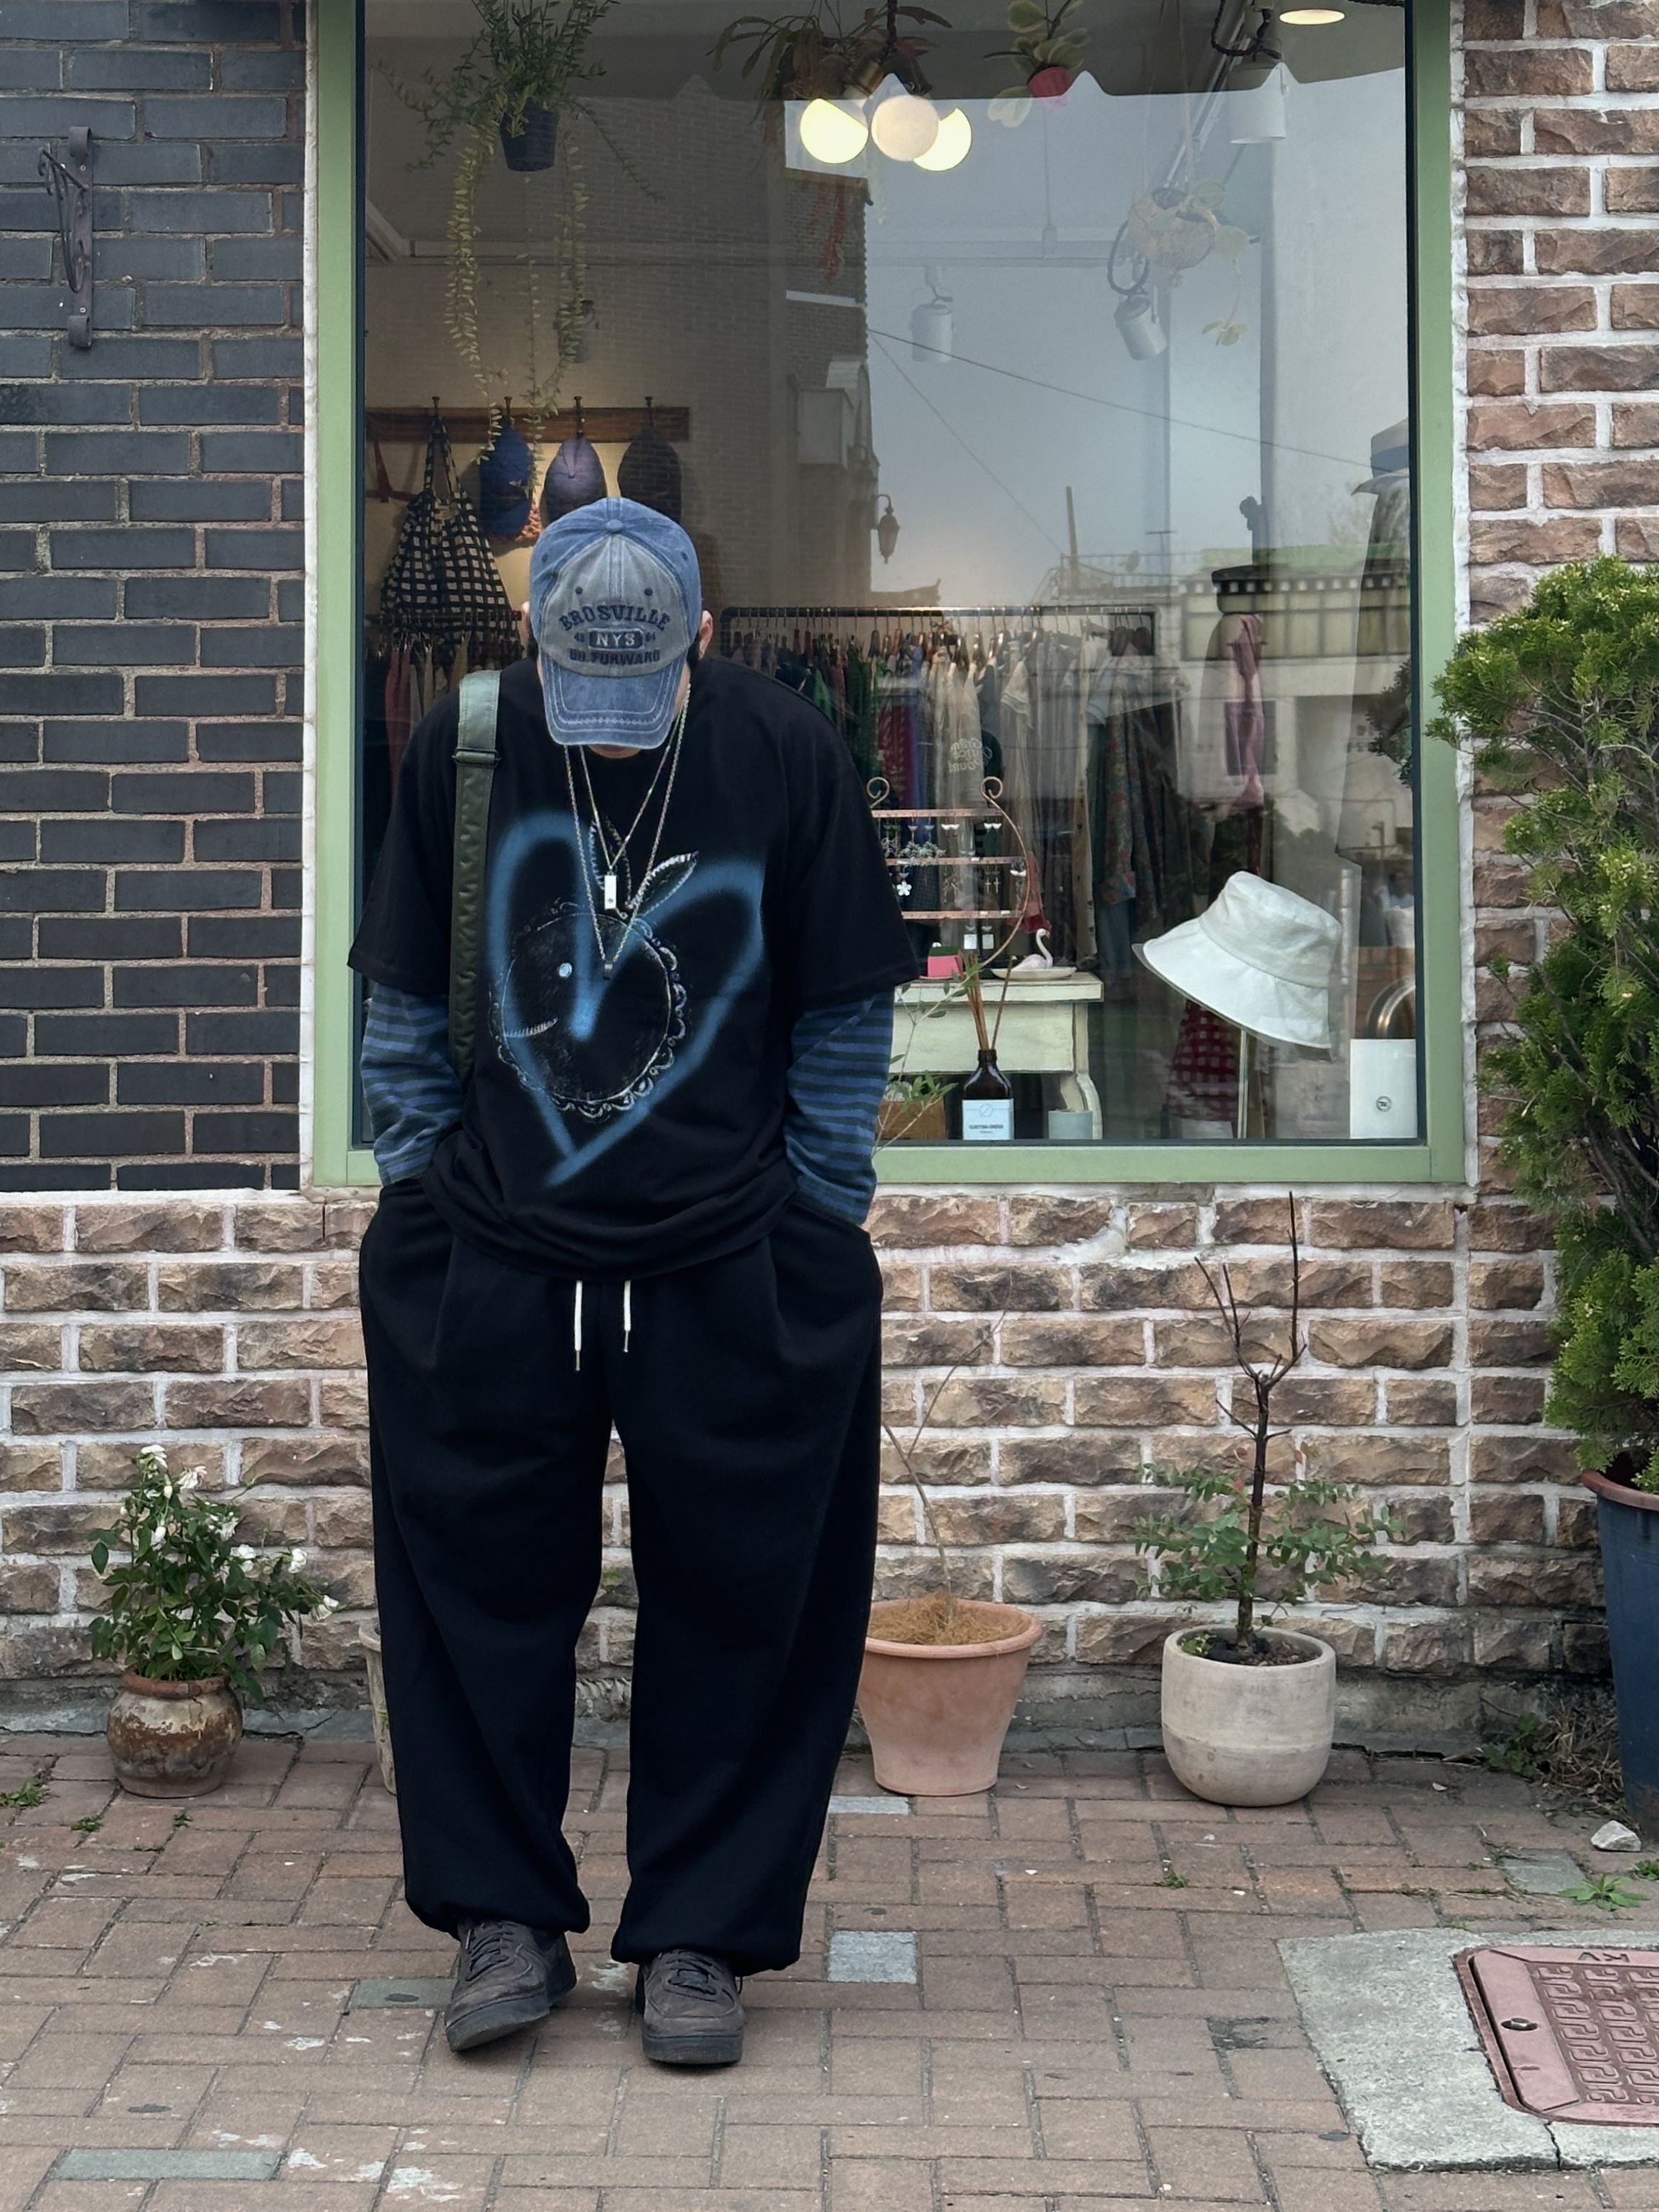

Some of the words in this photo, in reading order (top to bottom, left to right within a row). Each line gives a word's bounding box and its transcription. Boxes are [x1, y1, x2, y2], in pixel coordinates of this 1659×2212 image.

[559, 604, 671, 631] BROSVILLE
[596, 633, 635, 647] NYS
[592, 649, 660, 665] FORWARD
